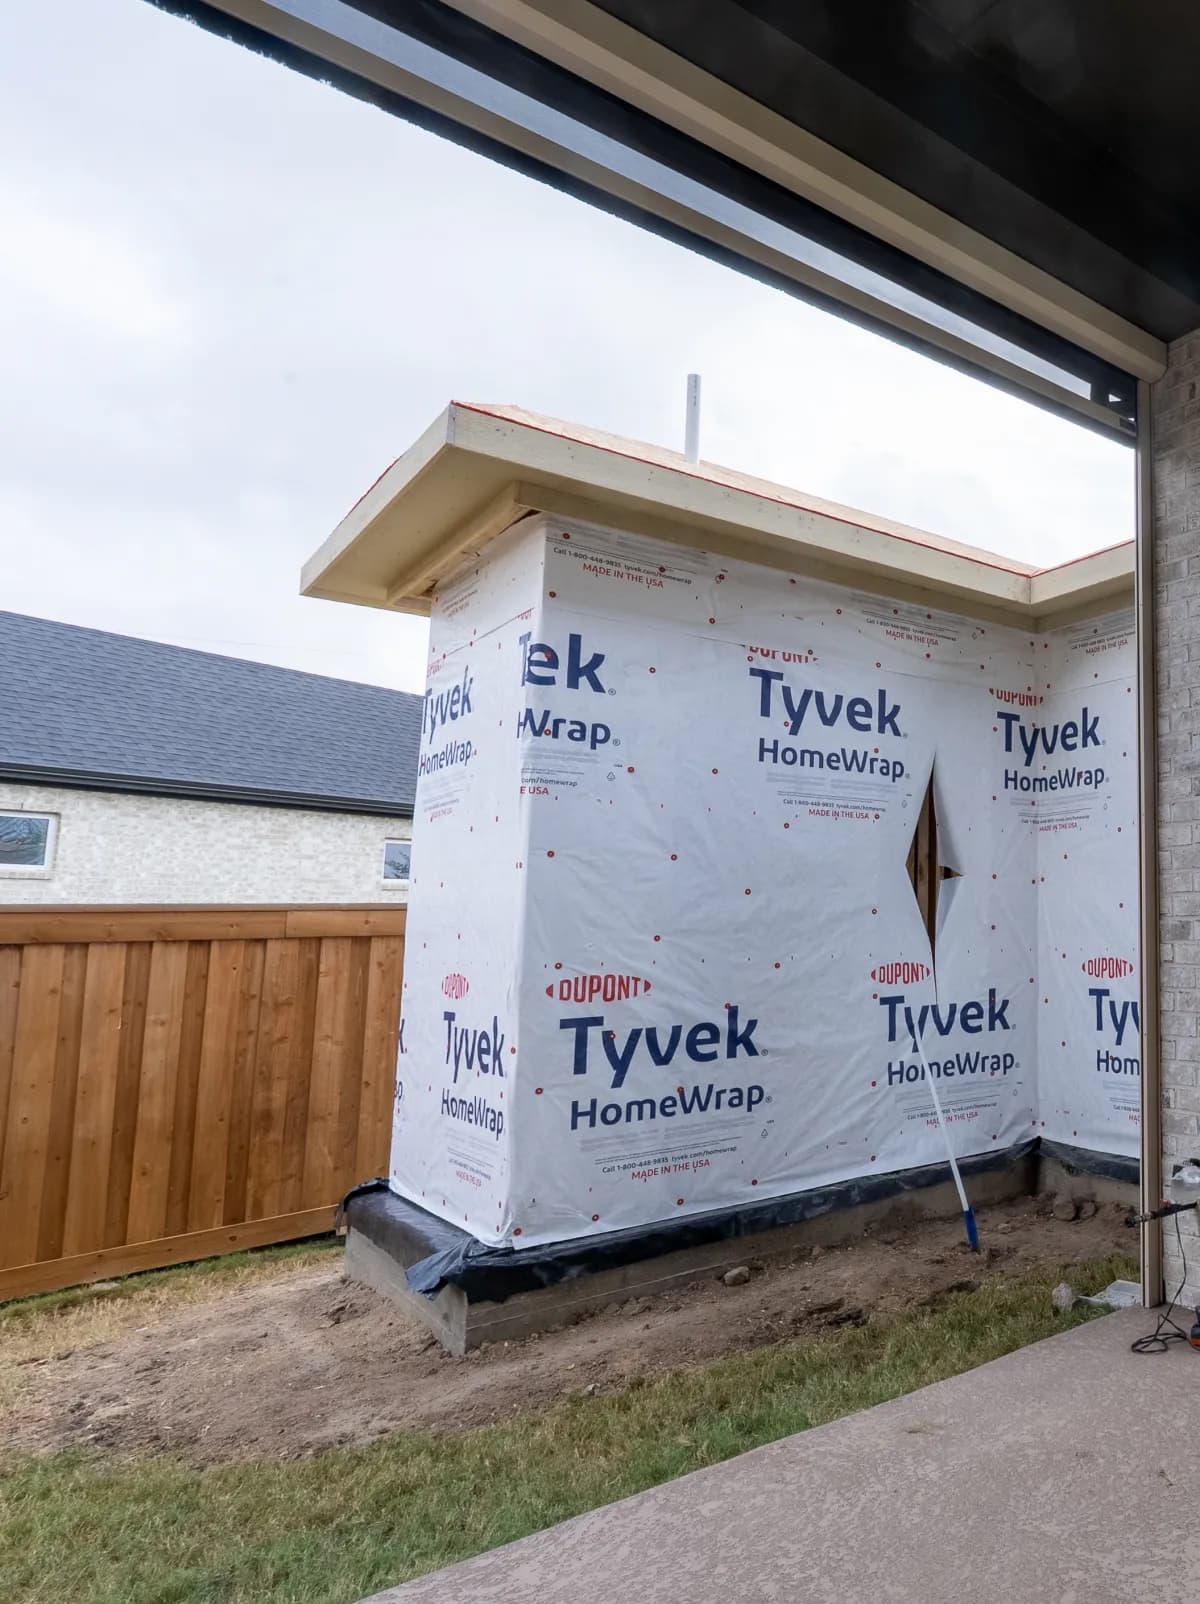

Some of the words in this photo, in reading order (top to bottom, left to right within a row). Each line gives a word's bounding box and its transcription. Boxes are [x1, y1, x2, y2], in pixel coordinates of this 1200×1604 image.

[553, 547, 566, 556] Call
[583, 563, 611, 577] MADE
[613, 568, 624, 579] IN
[625, 570, 644, 584] THE
[646, 575, 664, 588] USA
[886, 629, 905, 640] MADE
[906, 633, 913, 641] IN
[914, 635, 925, 644] THE
[926, 638, 939, 647] USA
[422, 665, 473, 745] Tyvek
[749, 667, 901, 737] Tyvek
[997, 706, 1101, 767] Tyvek
[418, 740, 472, 777] HomeWrap
[758, 738, 905, 783] HomeWrap
[528, 786, 550, 795] USA
[1004, 767, 1104, 793] HomeWrap
[808, 809, 831, 818] MADE
[832, 810, 840, 818] IN
[841, 811, 855, 819] THE
[856, 812, 870, 820] USA
[879, 962, 925, 985] DUPONT
[1087, 957, 1128, 979] DUPONT
[559, 974, 641, 1003] DUPONT
[879, 988, 1011, 1054] Tyvek
[443, 1011, 504, 1083] Tyvek
[560, 1005, 759, 1089] Tyvek
[887, 1051, 1015, 1086] HomeWrap
[441, 1087, 504, 1141] HomeWrap
[571, 1084, 764, 1130] HomeWrap
[954, 1113, 966, 1122] THE
[967, 1111, 979, 1120] USA
[602, 1165, 616, 1174] Call
[631, 1167, 658, 1181] MADE
[660, 1165, 671, 1176] IN
[672, 1162, 690, 1174] THE
[691, 1158, 711, 1171] USA
